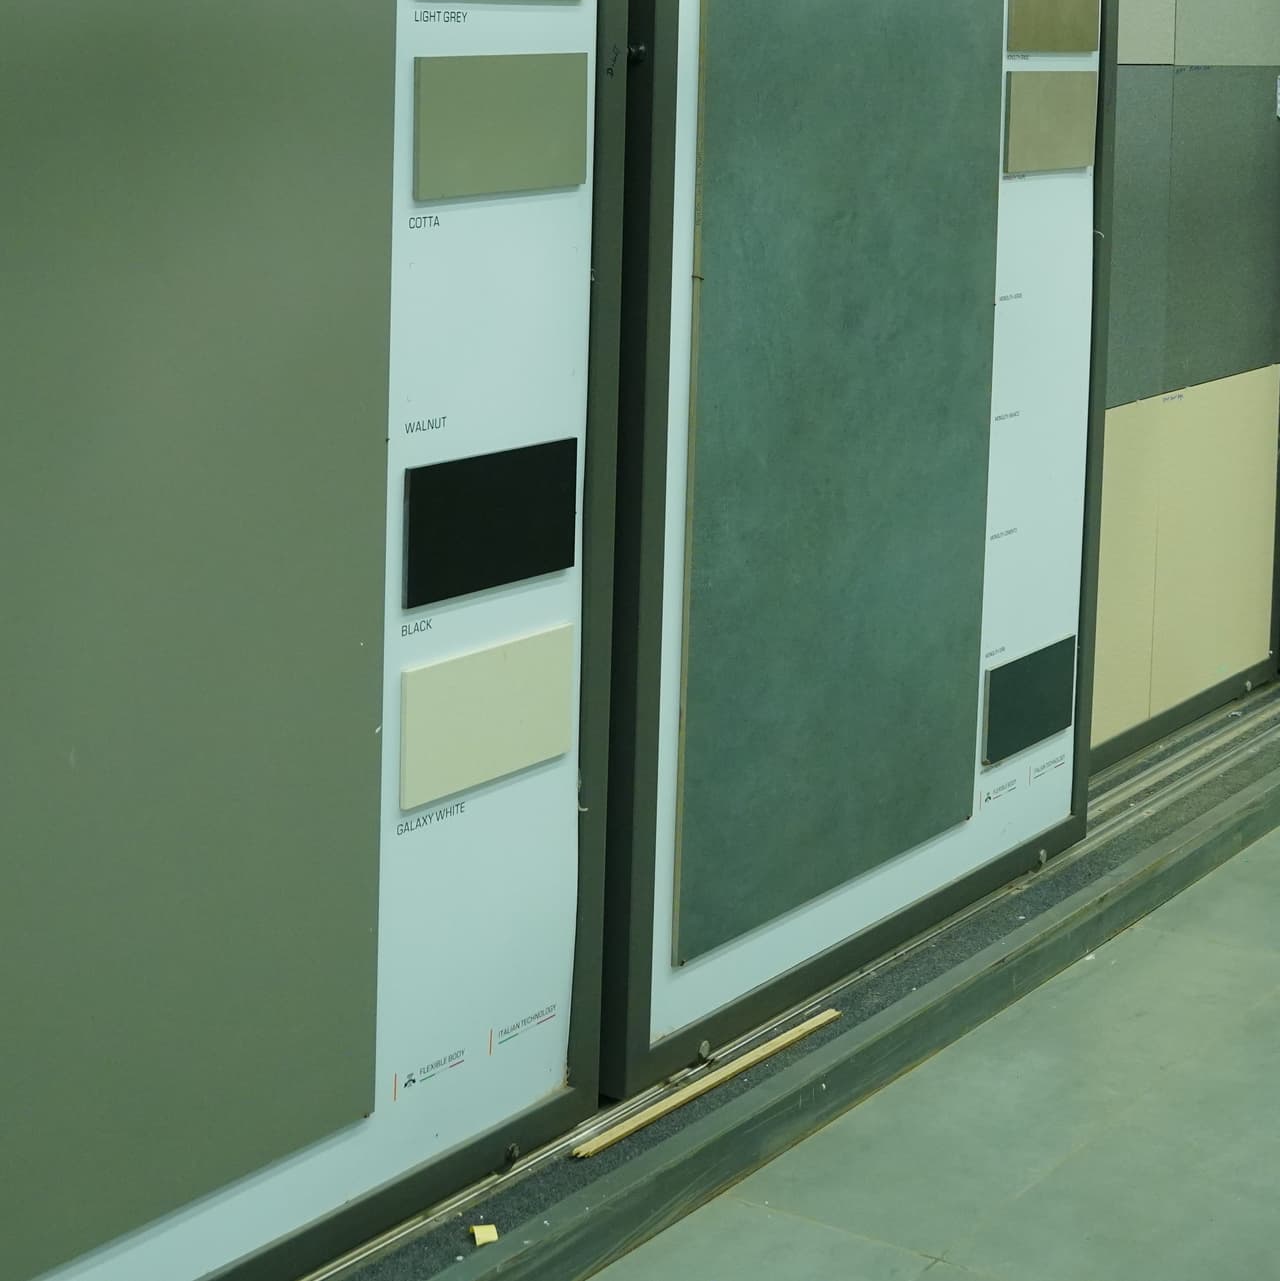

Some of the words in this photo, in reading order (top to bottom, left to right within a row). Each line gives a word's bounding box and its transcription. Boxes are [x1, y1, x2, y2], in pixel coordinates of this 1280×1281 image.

[414, 10, 441, 23] LIGHT
[443, 11, 468, 23] GREY
[409, 215, 440, 229] COTTA
[404, 416, 447, 434] WALNUT
[401, 618, 433, 637] BLACK
[396, 813, 434, 836] GALAXY
[435, 801, 465, 822] WHITE
